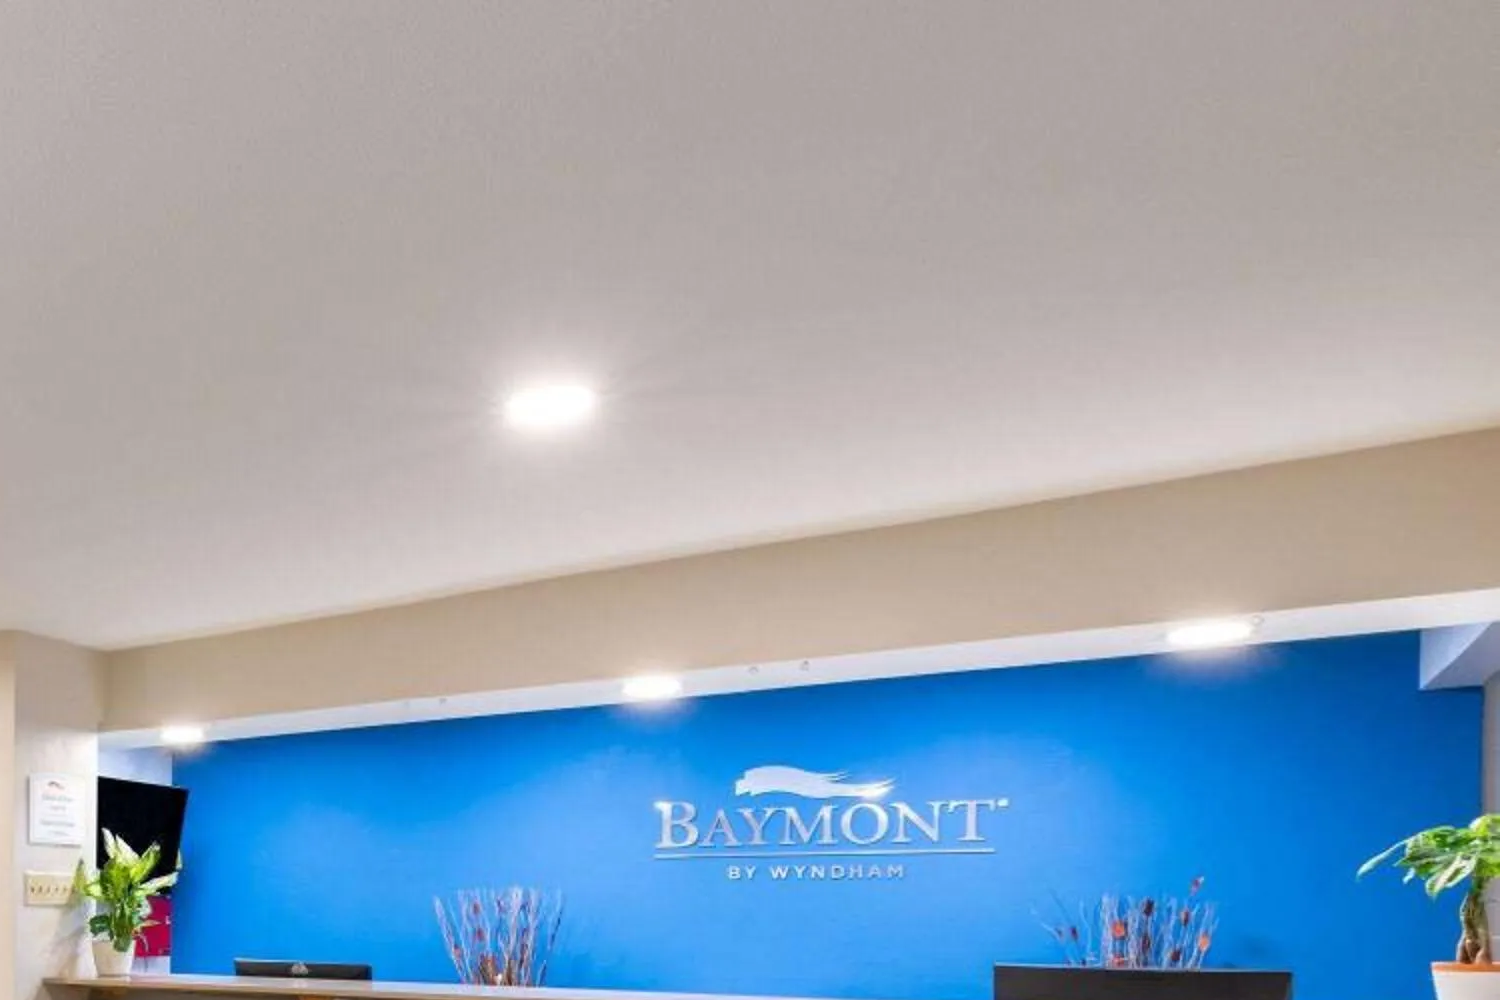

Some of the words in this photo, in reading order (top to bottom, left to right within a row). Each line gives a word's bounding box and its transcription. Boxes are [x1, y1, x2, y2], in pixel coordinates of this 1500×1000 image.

[653, 799, 996, 848] BAYMONT
[727, 865, 756, 880] BY
[769, 864, 904, 880] WYNDHAM
